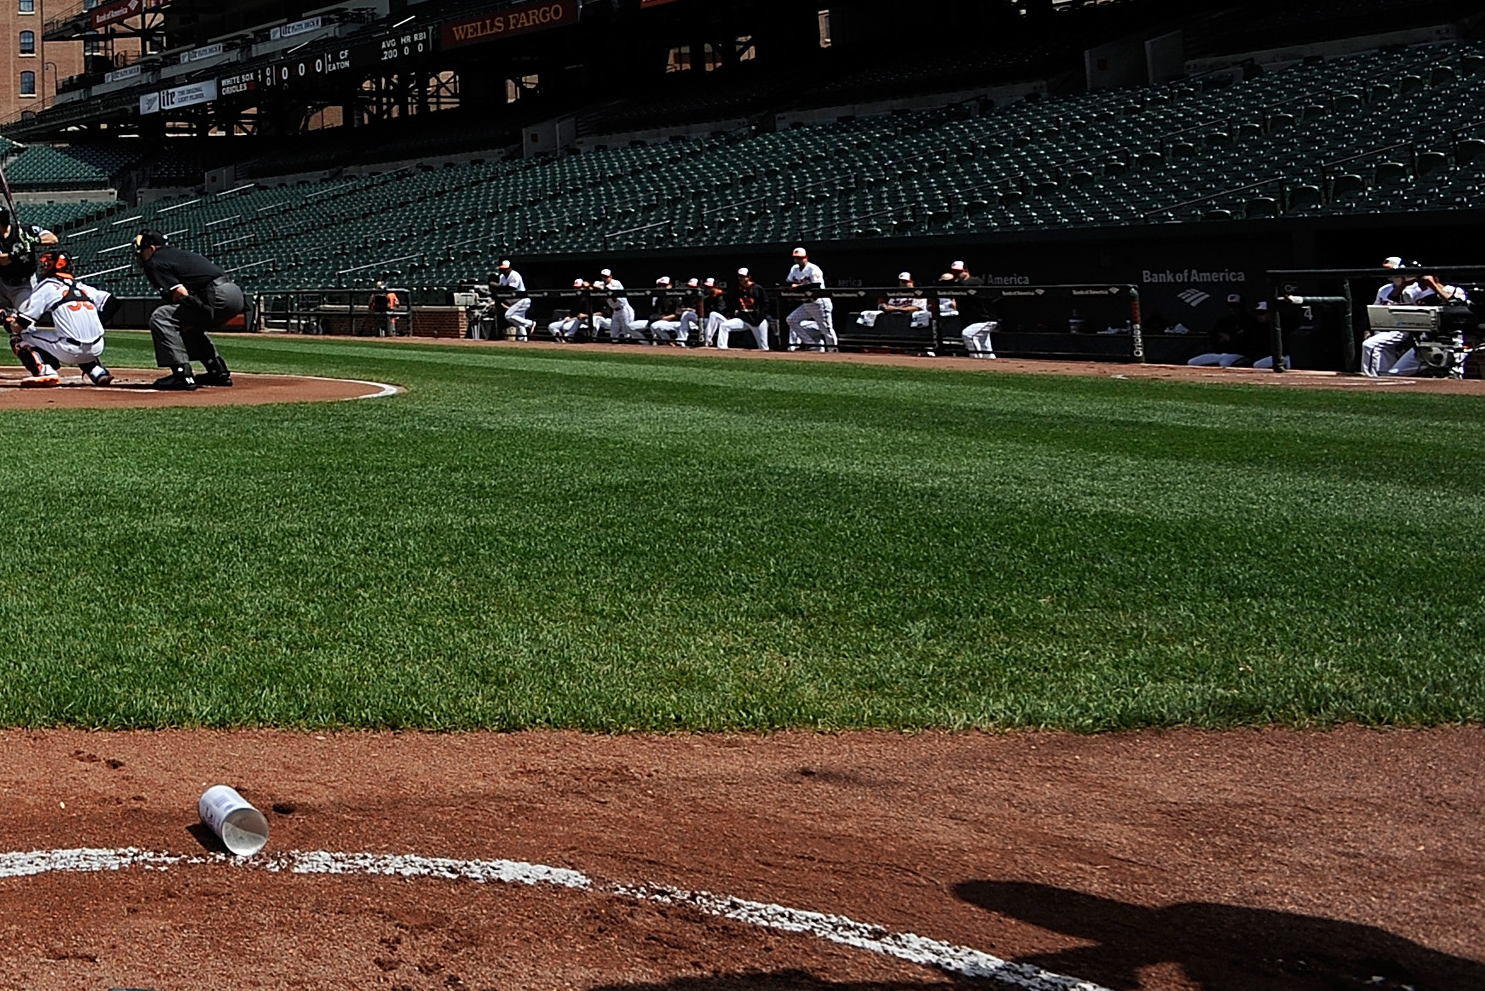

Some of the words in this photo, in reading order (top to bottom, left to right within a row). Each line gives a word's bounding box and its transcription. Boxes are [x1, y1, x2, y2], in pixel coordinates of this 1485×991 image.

[452, 17, 505, 42] WELLS
[508, 4, 563, 30] FARGO
[382, 39, 397, 49] AVG
[400, 35, 412, 45] HR
[413, 32, 426, 42] RBI
[328, 54, 332, 62] 1
[339, 50, 350, 60] CF
[381, 49, 398, 60] .200
[404, 46, 410, 55] 0
[418, 43, 424, 52] 0
[221, 76, 241, 87] WHITE
[242, 73, 255, 83] SOX
[266, 67, 271, 76] 0
[281, 66, 289, 80] 0
[298, 63, 306, 77] 0
[315, 59, 323, 73] 0
[327, 61, 350, 72] EATON
[222, 83, 248, 95] ORIOLES
[987, 273, 1029, 286] America
[1143, 269, 1175, 283] Bank
[1176, 269, 1189, 282] of
[1190, 269, 1245, 282] America
[1132, 323, 1144, 357] Orioles
